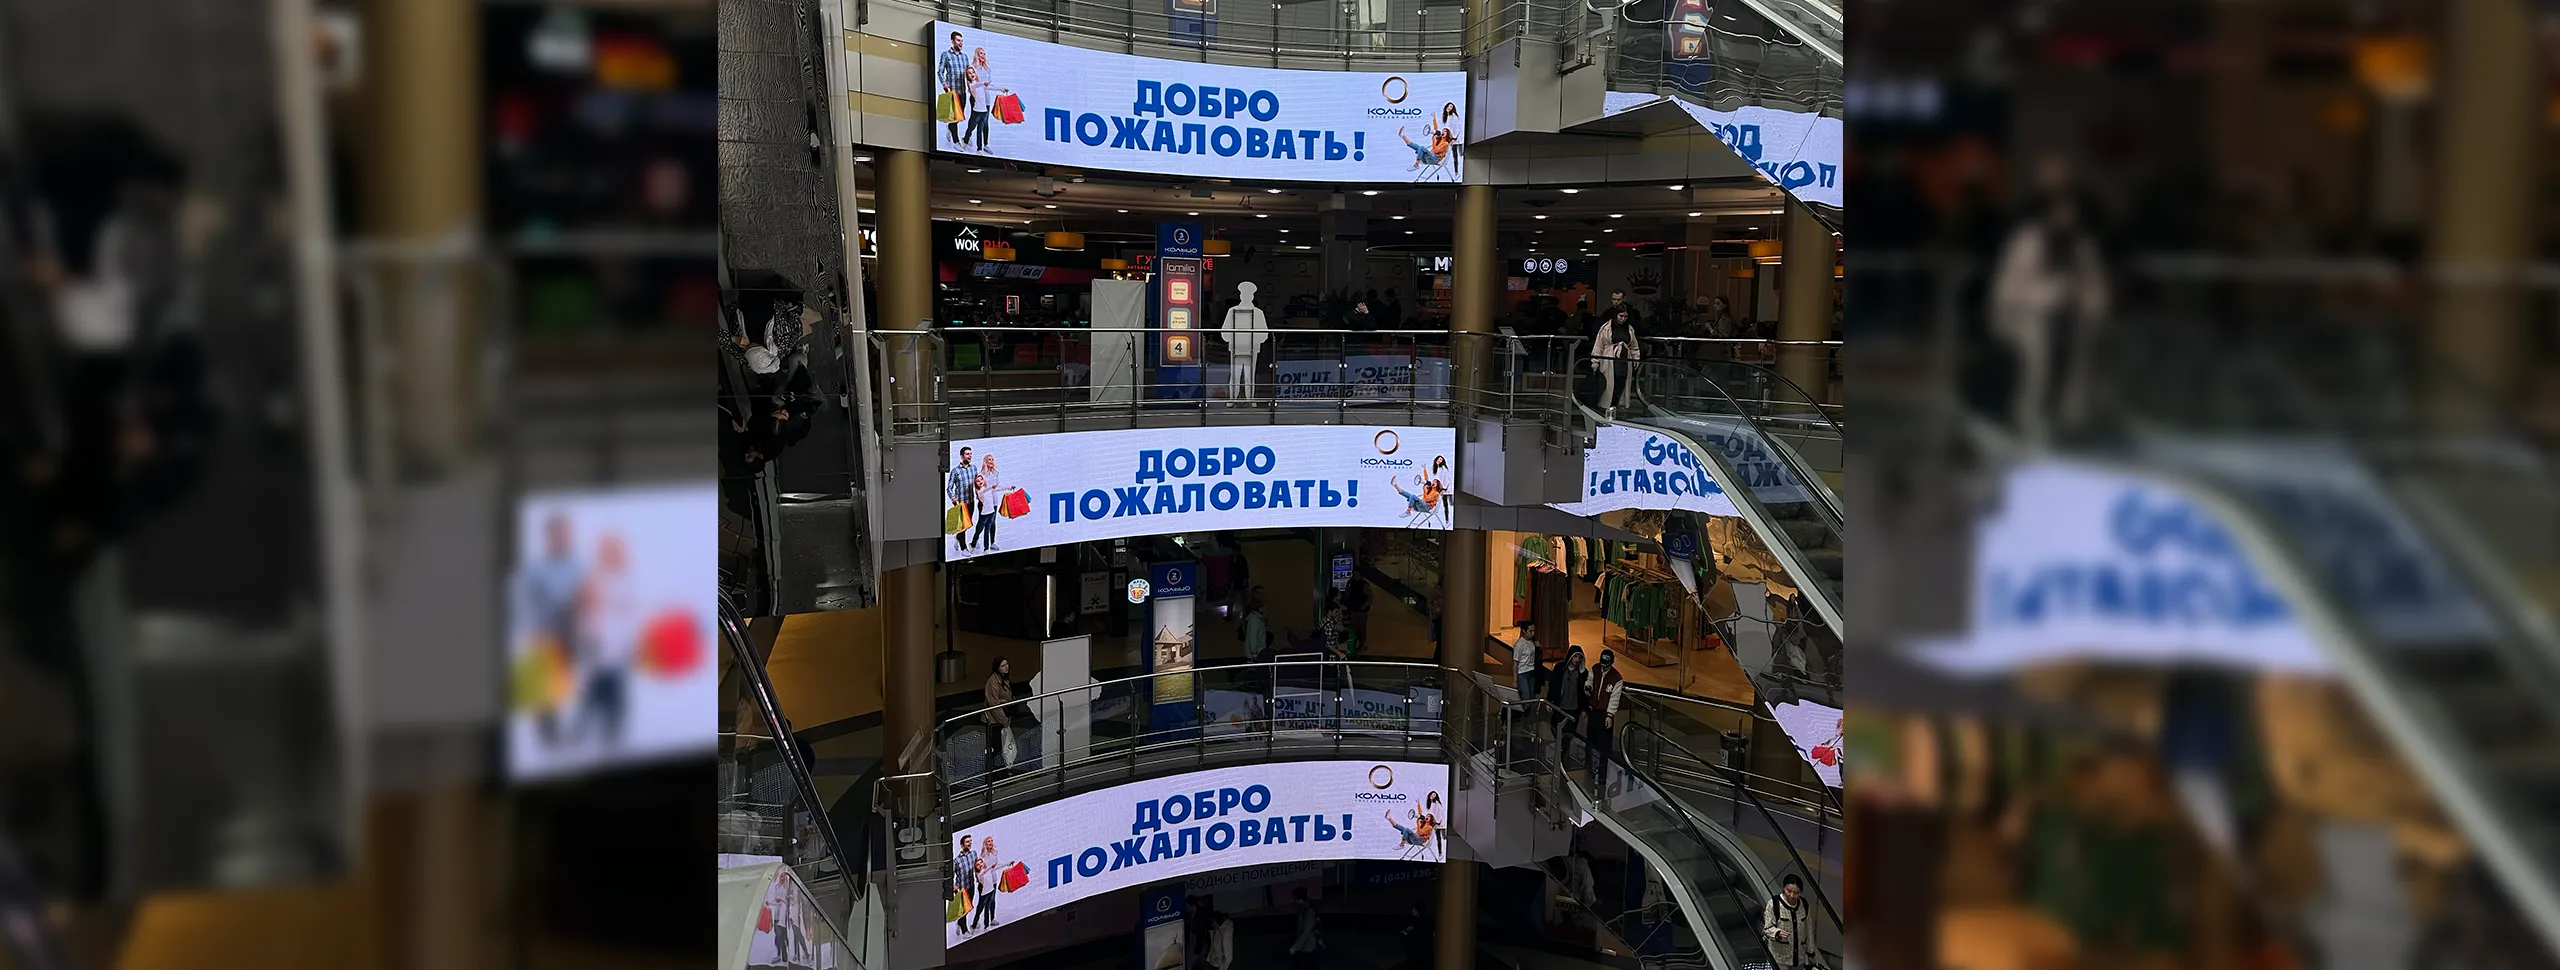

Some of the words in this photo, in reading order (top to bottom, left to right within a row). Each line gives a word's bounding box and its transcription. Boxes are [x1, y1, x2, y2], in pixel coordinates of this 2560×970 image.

[1133, 79, 1280, 123] ДОБРО
[1367, 107, 1422, 116] КОЛЬЦО
[1044, 107, 1366, 162] ПОЖАЛОВАТЬ!
[954, 238, 980, 252] WOK
[1166, 262, 1196, 272] familia
[1174, 342, 1183, 352] 4
[1135, 445, 1276, 484] ДОБРО
[1360, 458, 1413, 467] КОЛЬЦО
[1049, 479, 1358, 524] ПОЖАЛОВАТЬ!
[1157, 585, 1191, 593] КОЛЬЦО
[1354, 792, 1407, 801] КОЛЬЦО
[1133, 783, 1271, 835] ДОБРО
[1047, 812, 1353, 889] ПОЖАЛОВАТЬ!
[1241, 861, 1317, 882] ПОМЕЩЕНИЕ
[1147, 910, 1181, 923] КОЛЬЦО
